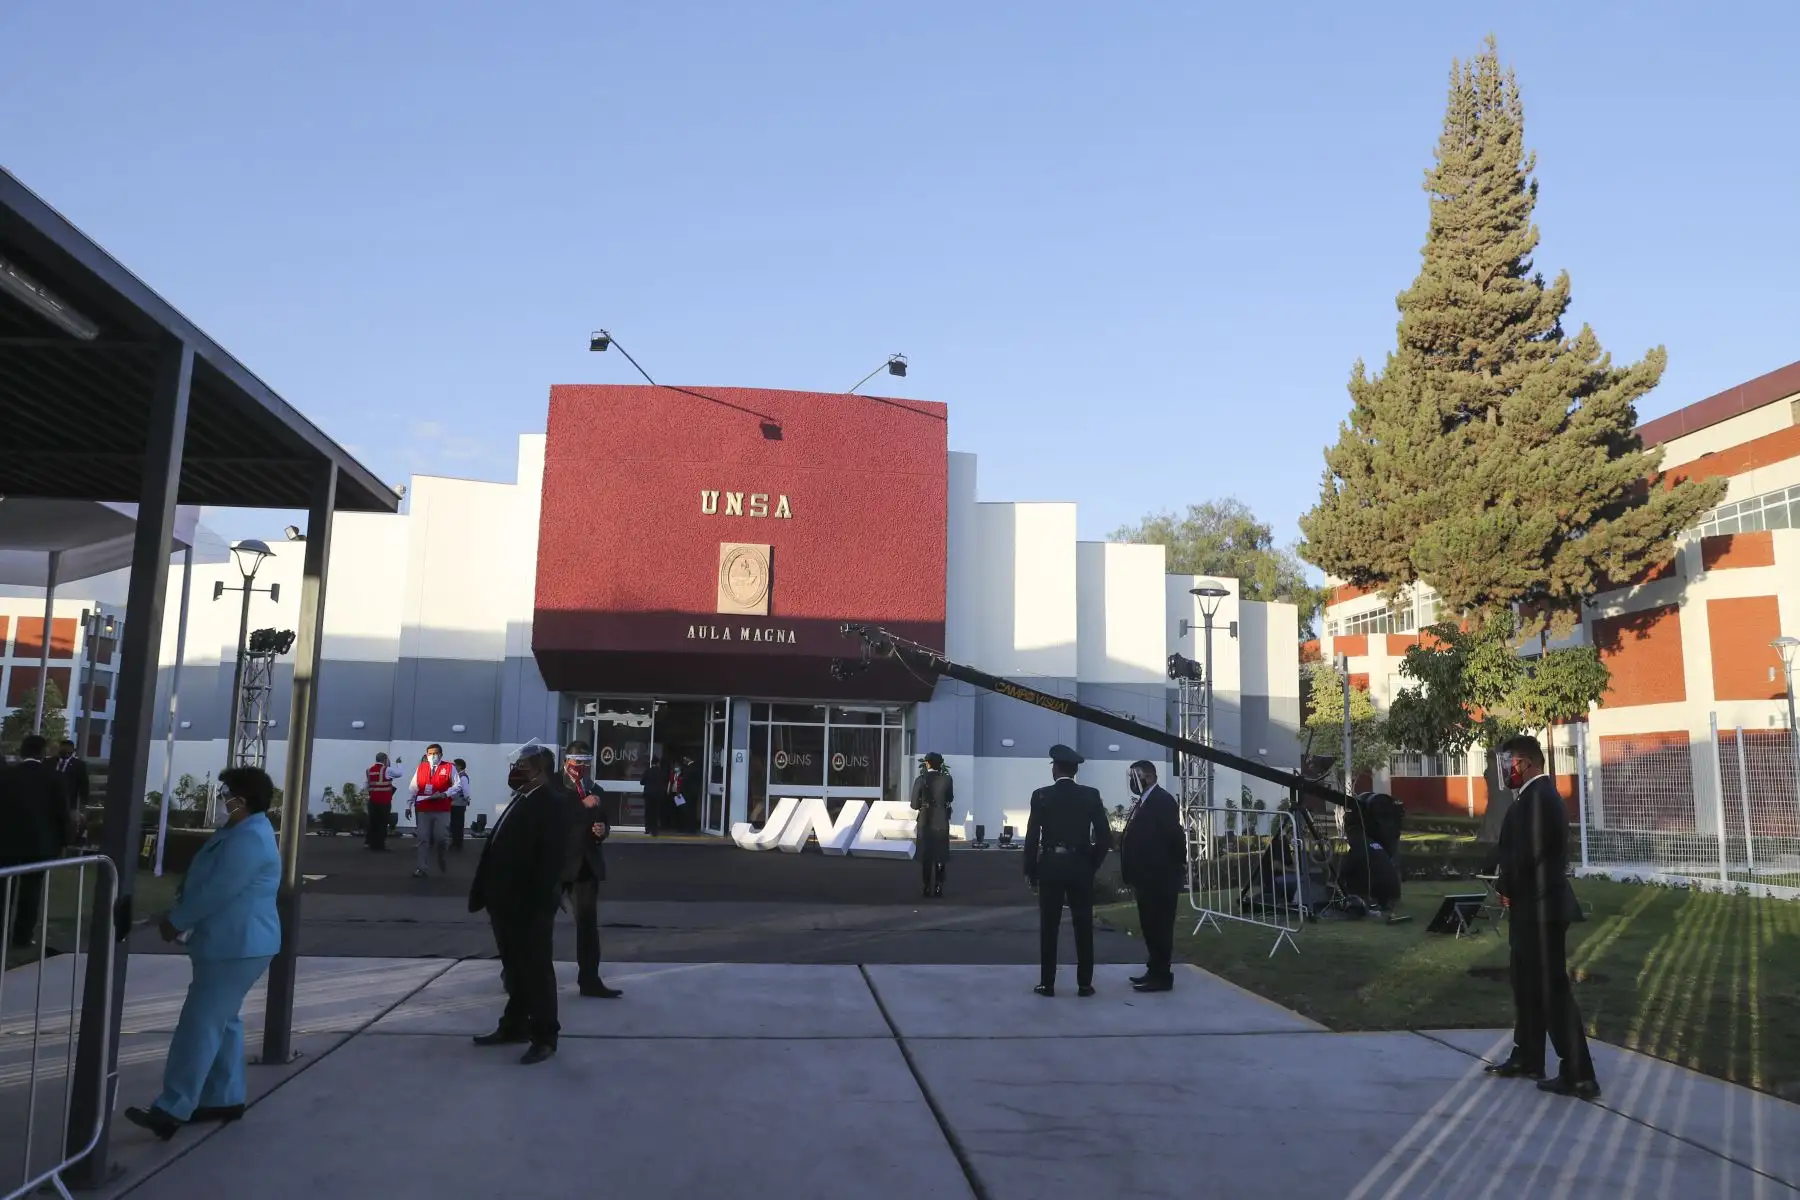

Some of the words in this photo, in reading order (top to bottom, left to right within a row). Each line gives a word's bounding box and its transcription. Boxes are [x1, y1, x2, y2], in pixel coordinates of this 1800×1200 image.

[701, 490, 792, 519] UNSA
[687, 625, 731, 640] AULA
[740, 627, 796, 644] MAGNA
[731, 797, 919, 860] JNE
